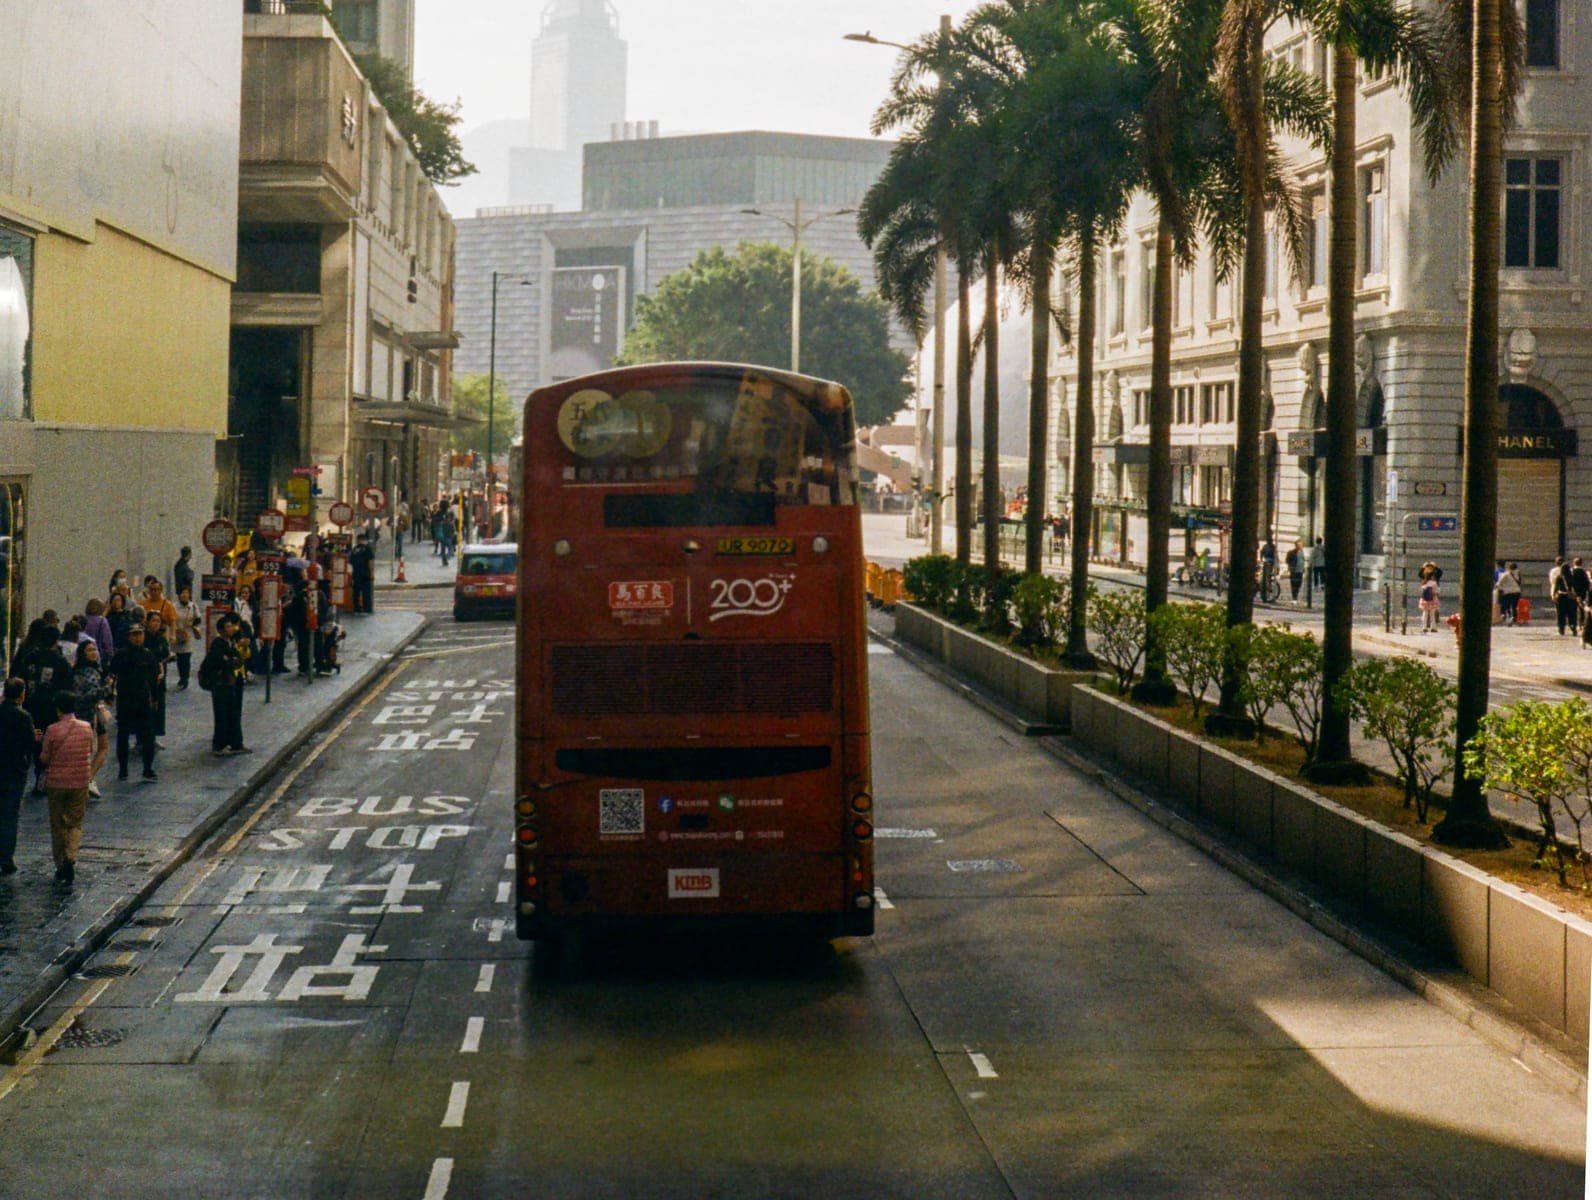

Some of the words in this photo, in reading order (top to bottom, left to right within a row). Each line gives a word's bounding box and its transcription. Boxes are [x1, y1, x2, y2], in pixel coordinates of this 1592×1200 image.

[1497, 435, 1555, 449] HANEL
[295, 796, 471, 817] BUS
[258, 825, 470, 850] STOP
[173, 933, 389, 1002] 站
